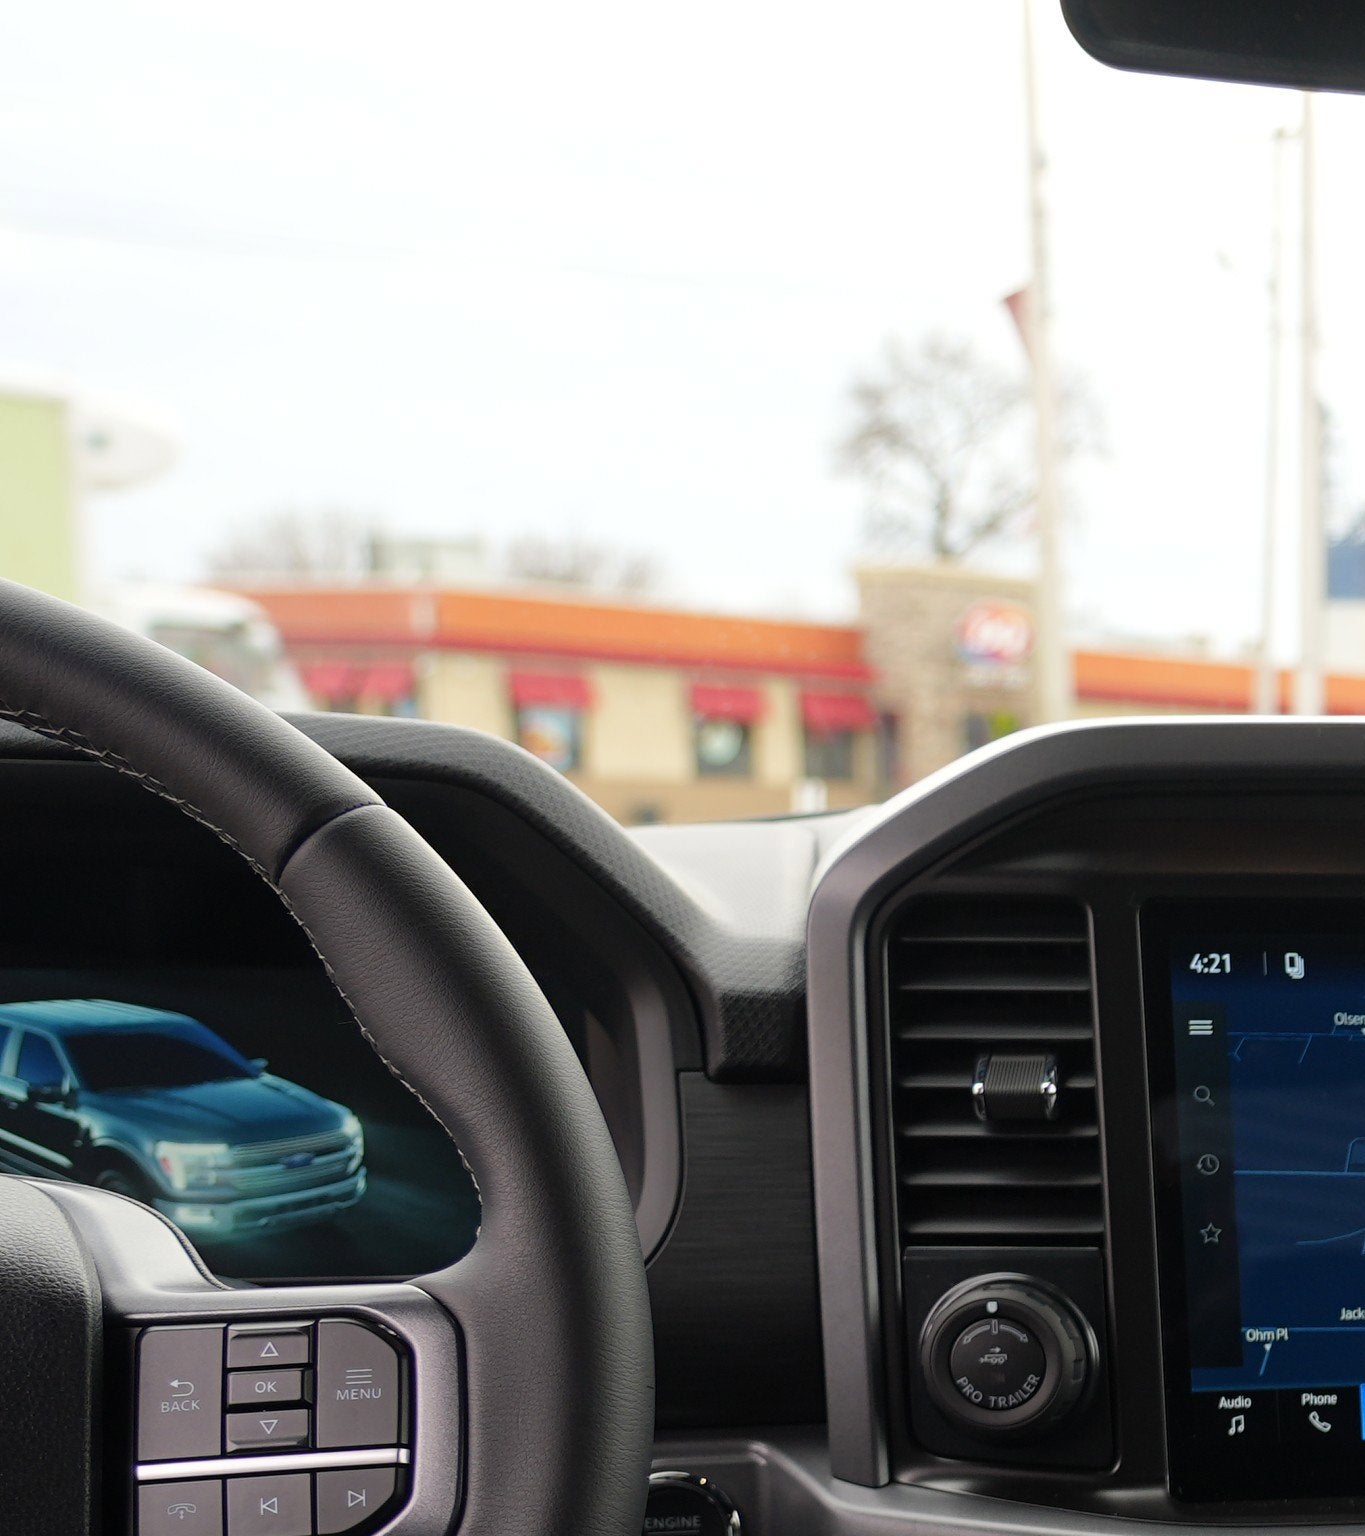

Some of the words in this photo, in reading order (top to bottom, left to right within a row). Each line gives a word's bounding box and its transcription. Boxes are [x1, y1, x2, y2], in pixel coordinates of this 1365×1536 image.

[1190, 953, 1231, 974] 4:21
[1246, 1328, 1275, 1342] Ohm
[1276, 1327, 1289, 1341] Pl
[254, 1381, 277, 1393] OK
[956, 1376, 983, 1402] PRO
[989, 1374, 1041, 1408] TRAILER
[336, 1388, 382, 1401] MENU
[1301, 1393, 1338, 1406] Phone
[161, 1400, 200, 1413] BACK
[1218, 1396, 1251, 1409] Audio
[644, 1515, 701, 1529] ENGINE
